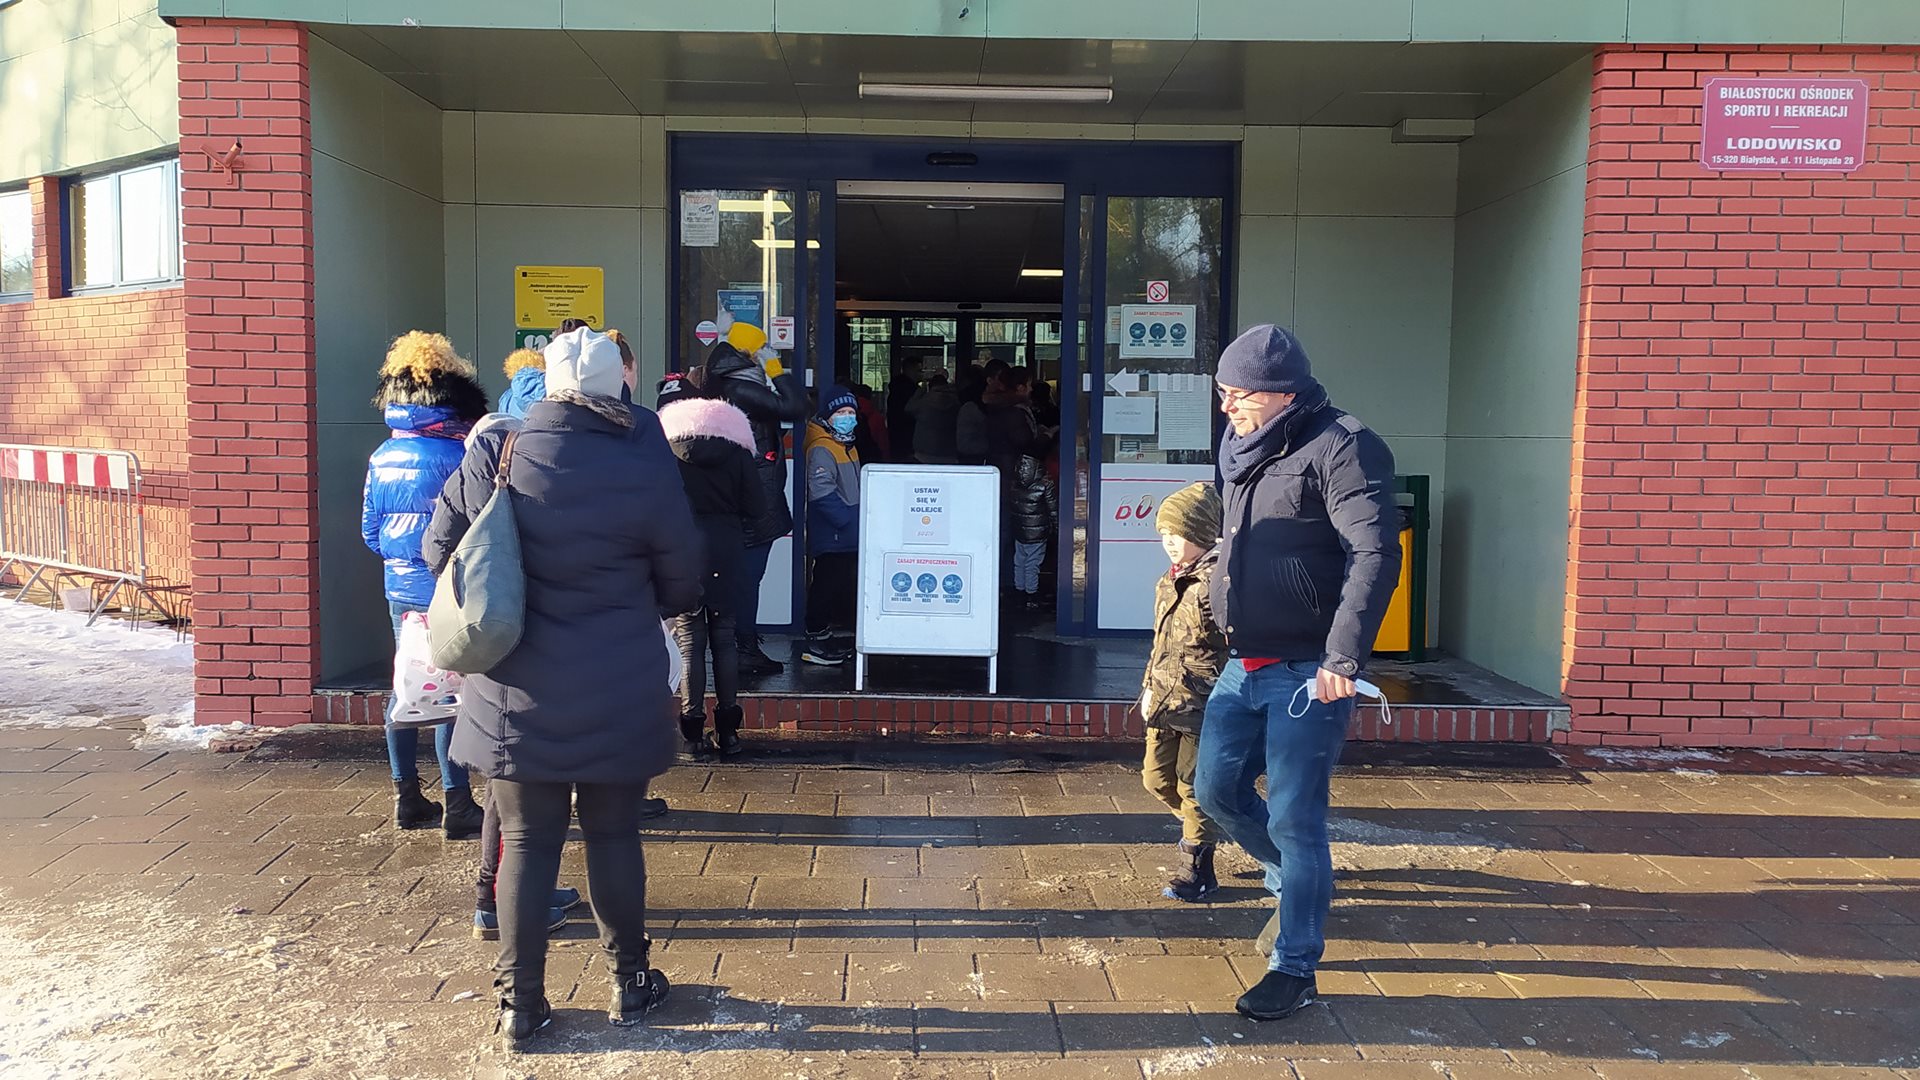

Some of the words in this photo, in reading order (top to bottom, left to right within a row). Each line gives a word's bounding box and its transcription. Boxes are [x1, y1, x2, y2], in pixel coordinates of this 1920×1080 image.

[1720, 87, 1796, 100] BIAŁOSTOCKI
[1800, 85, 1854, 100] OŚRODEK
[1724, 105, 1771, 117] SPORTU
[1775, 105, 1779, 117] I
[1784, 105, 1848, 118] REKREACJI
[1727, 137, 1842, 151] LODOWISKO
[1712, 155, 1738, 164] 15-320
[1740, 155, 1778, 165] Białystok,
[1794, 156, 1802, 164] 11
[1805, 156, 1842, 166] Listopada
[827, 395, 858, 411] PUM
